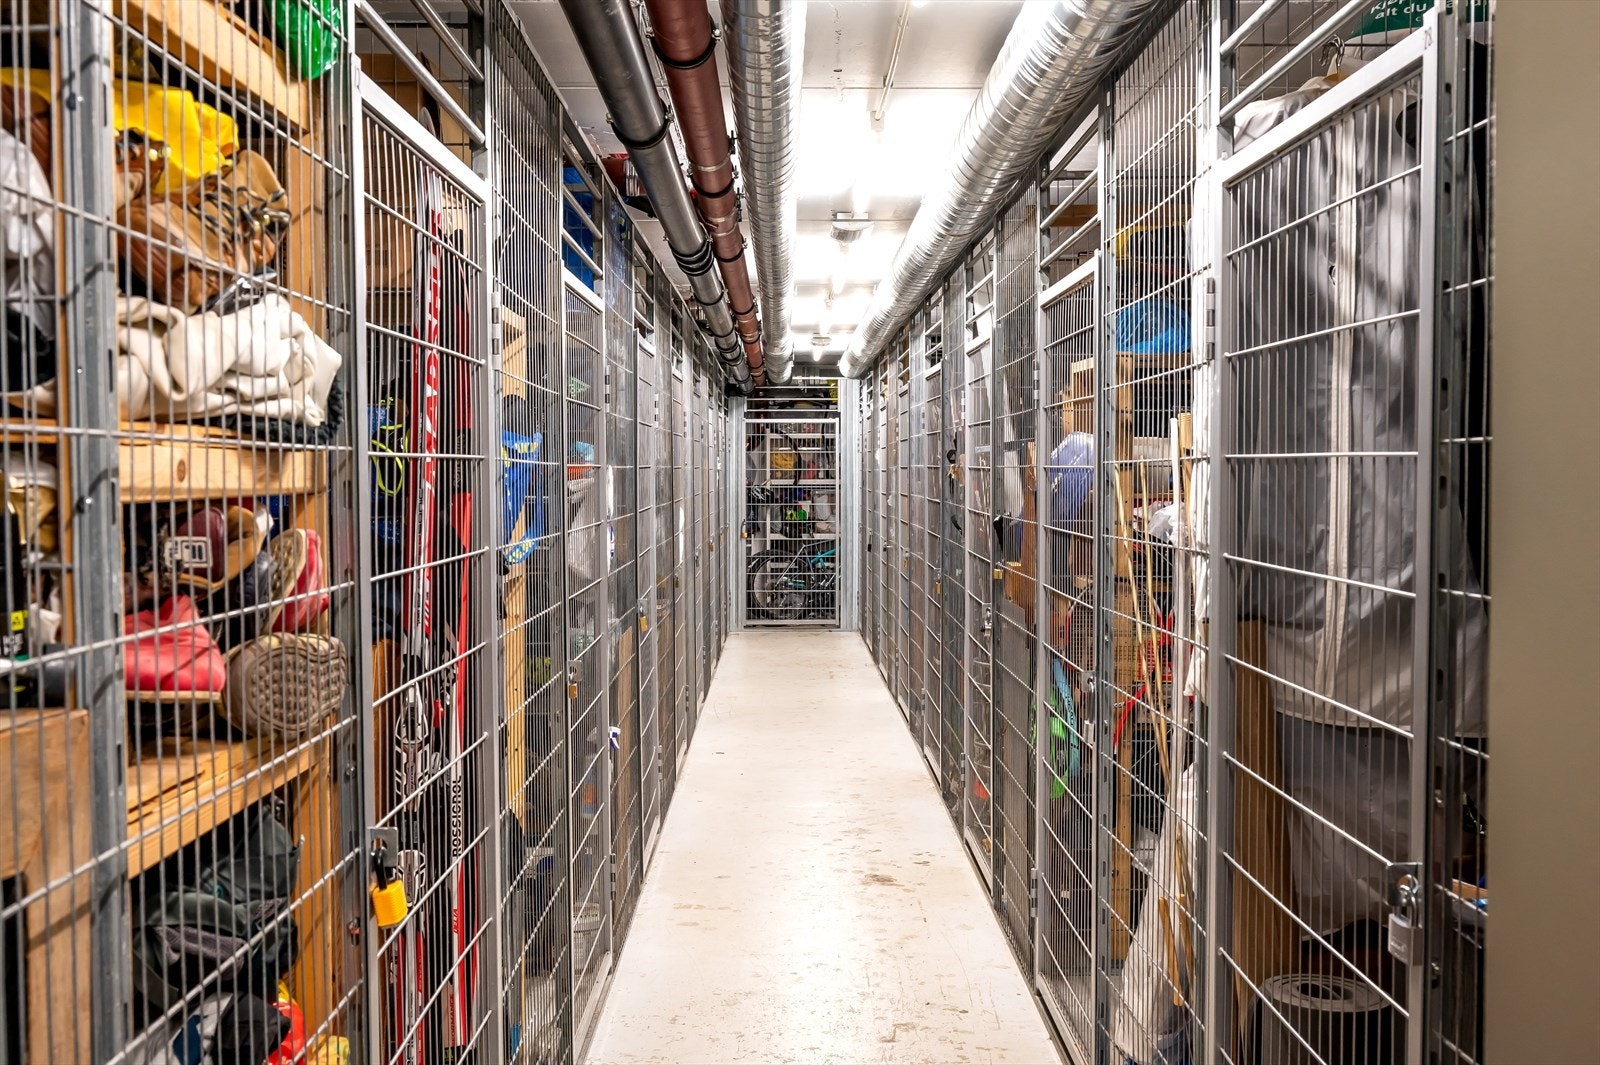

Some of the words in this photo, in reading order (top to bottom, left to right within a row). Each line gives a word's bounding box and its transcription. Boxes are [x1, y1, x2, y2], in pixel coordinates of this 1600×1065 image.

[1375, 7, 1398, 19] alt
[1403, 2, 1427, 14] du
[451, 775, 462, 858] ROSSIGNOL
